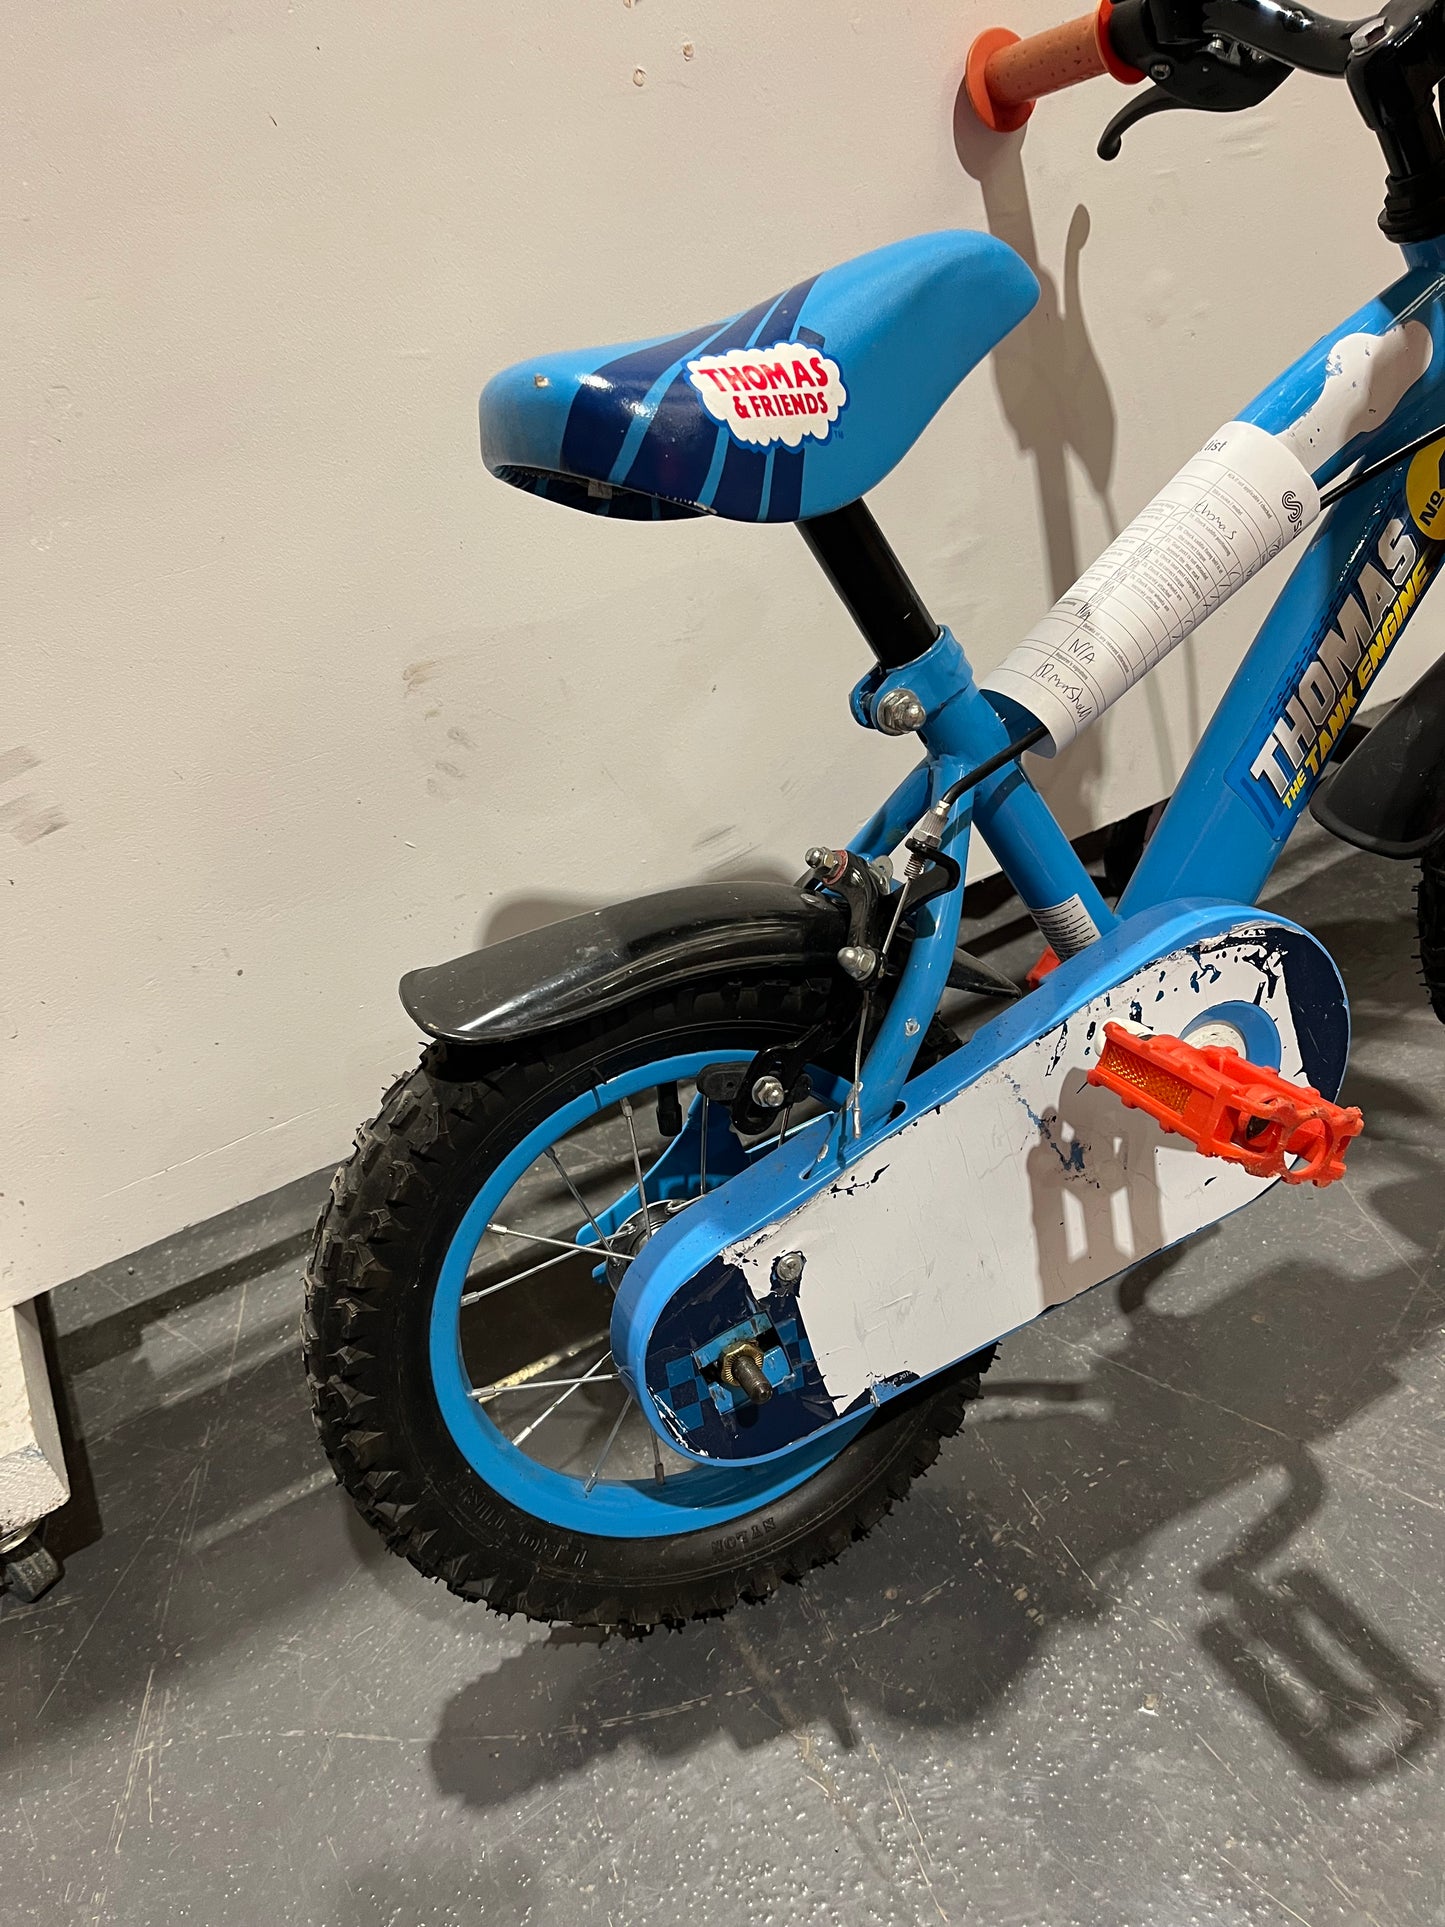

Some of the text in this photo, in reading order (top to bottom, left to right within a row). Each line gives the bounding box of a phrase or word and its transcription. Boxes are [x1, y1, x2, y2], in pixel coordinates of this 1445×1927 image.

[697, 357, 828, 392] THOMAS
[733, 392, 828, 419] & FRIENDS
[1204, 439, 1228, 452] list
[1250, 518, 1417, 797] THOMAS
[1282, 562, 1432, 809] THE TANK ENGINE
[711, 1517, 777, 1554] NYLON
